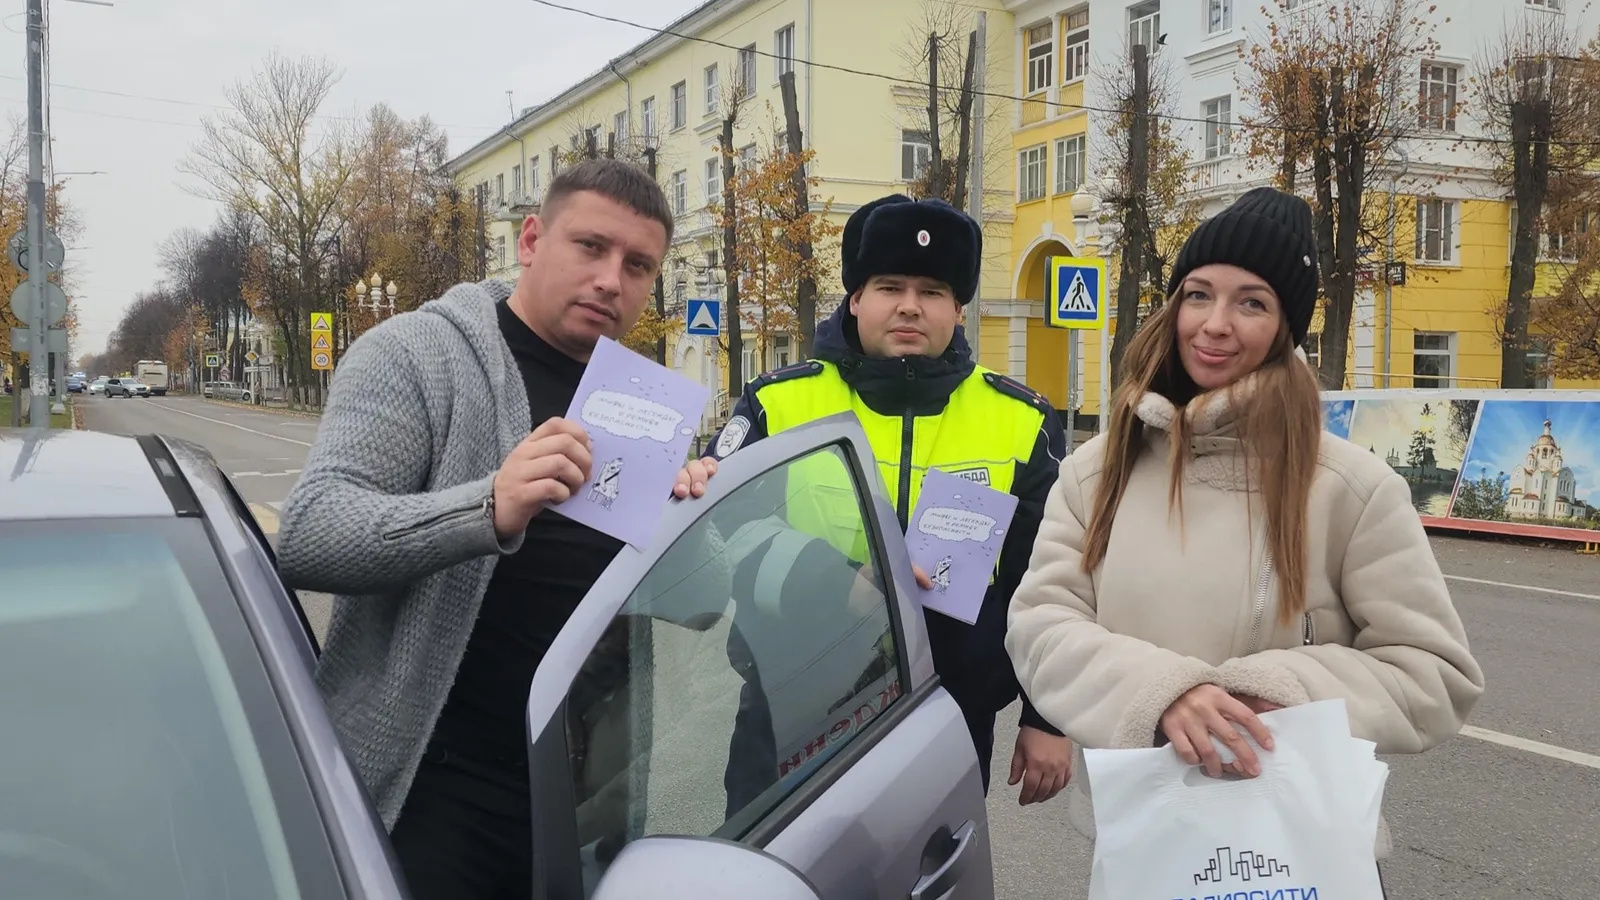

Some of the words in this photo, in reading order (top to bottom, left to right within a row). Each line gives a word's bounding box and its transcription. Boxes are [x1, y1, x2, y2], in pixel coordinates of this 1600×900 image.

[588, 411, 651, 432] БЕЗОПАСНОСТИ
[923, 523, 971, 535] БЕЗОПАСНОСТИ
[1172, 886, 1318, 900] ОСИТИ
